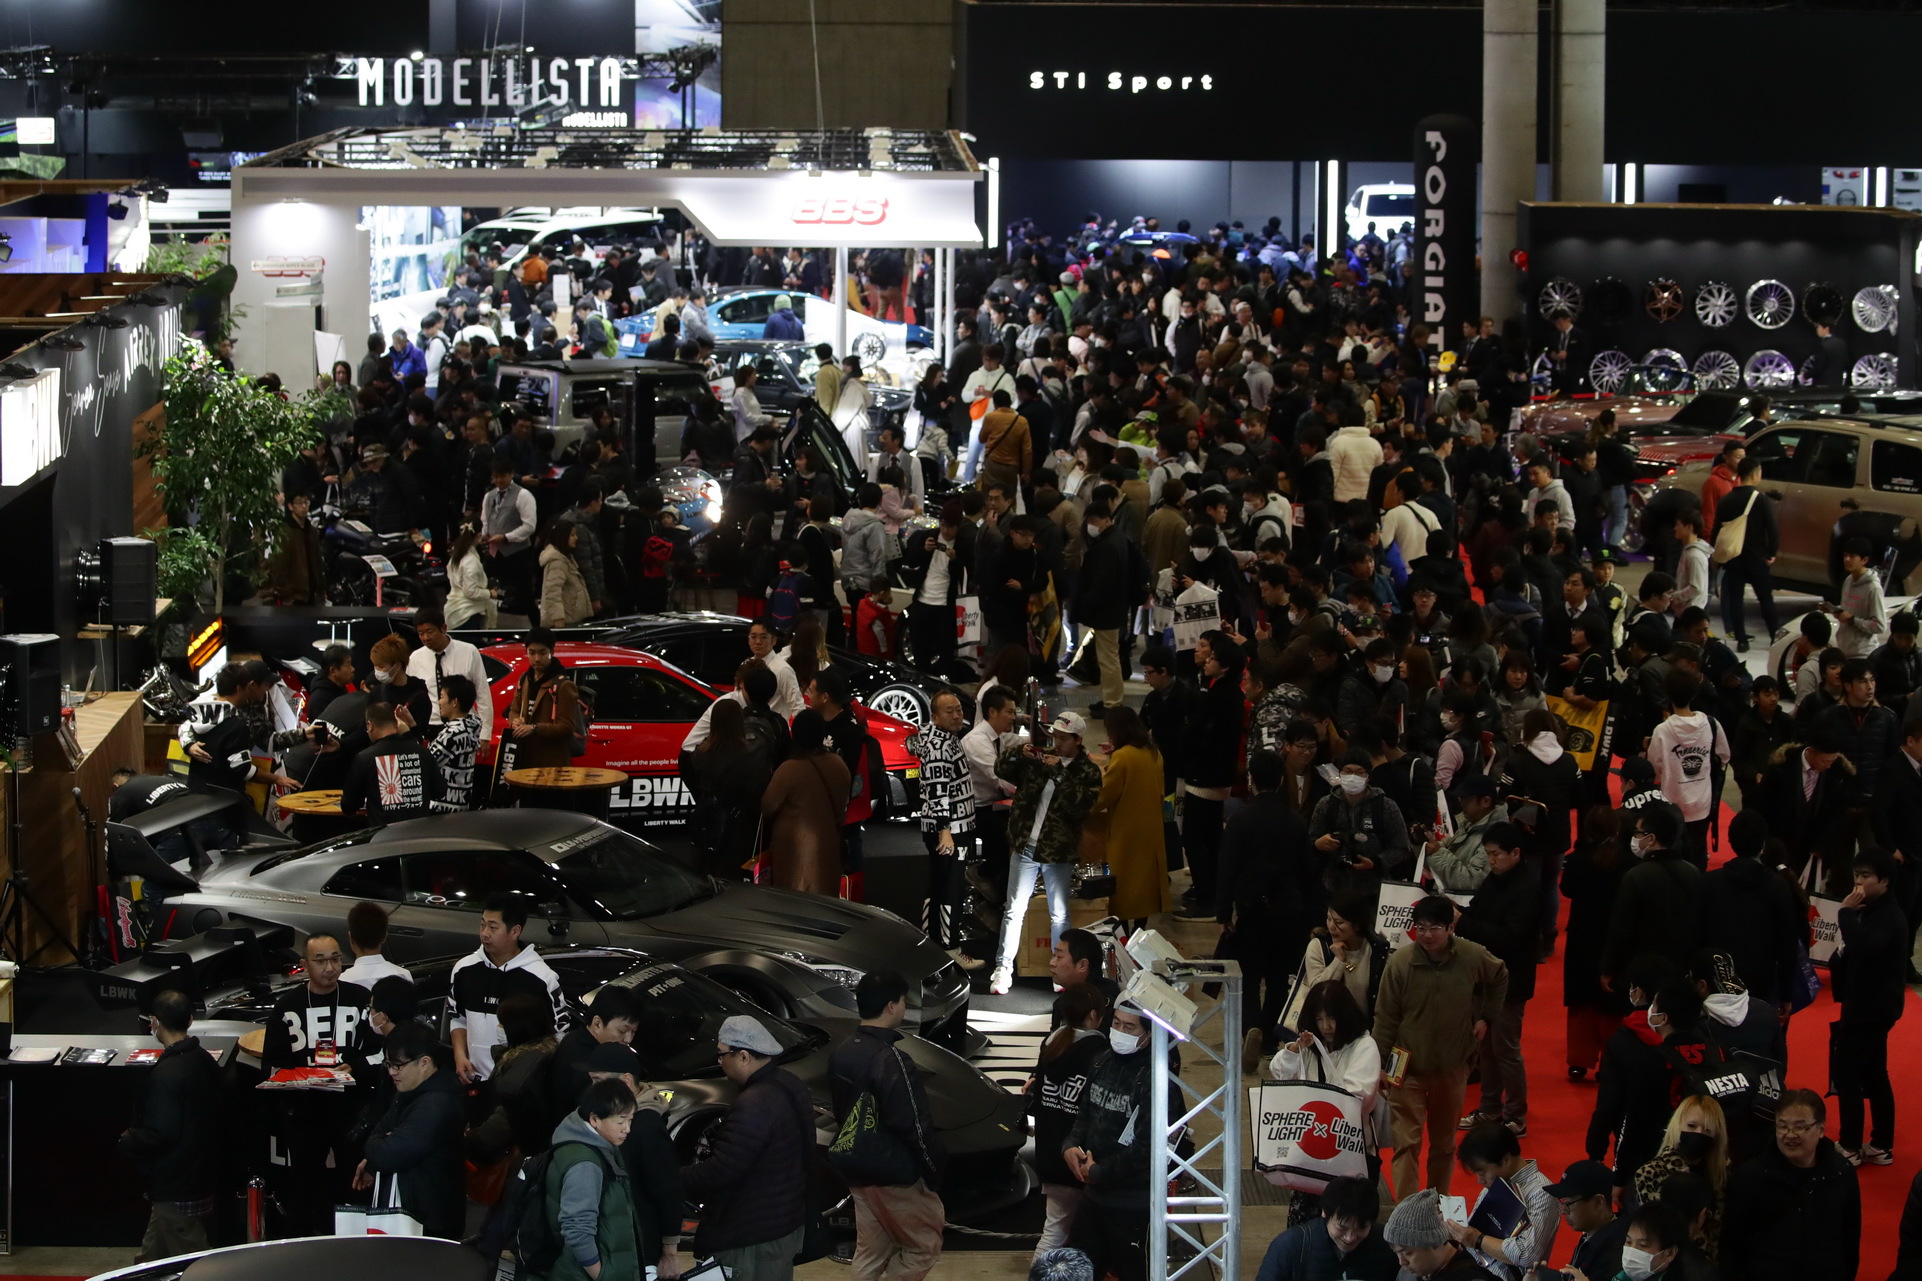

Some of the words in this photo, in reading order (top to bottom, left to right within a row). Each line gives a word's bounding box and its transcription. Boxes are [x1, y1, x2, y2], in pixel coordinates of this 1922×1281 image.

[358, 57, 621, 107] MODELLISTA
[1030, 71, 1086, 90] STI
[1107, 71, 1213, 94] Sport
[791, 196, 890, 226] BBS
[1424, 130, 1447, 353] FORGIAT
[649, 759, 667, 767] people
[401, 774, 422, 787] cars
[403, 785, 423, 796] around
[1379, 905, 1415, 918] SPHER
[1383, 918, 1414, 931] LIGHT
[1812, 917, 1839, 934] Liberty
[1814, 930, 1836, 942] Walk
[100, 985, 137, 1000] LBWK
[1704, 1072, 1750, 1096] NESTA
[1262, 1112, 1314, 1126] SPHERE
[1331, 1119, 1363, 1139] Liber
[1267, 1126, 1306, 1141] LIGHT
[1336, 1134, 1365, 1155] Walk
